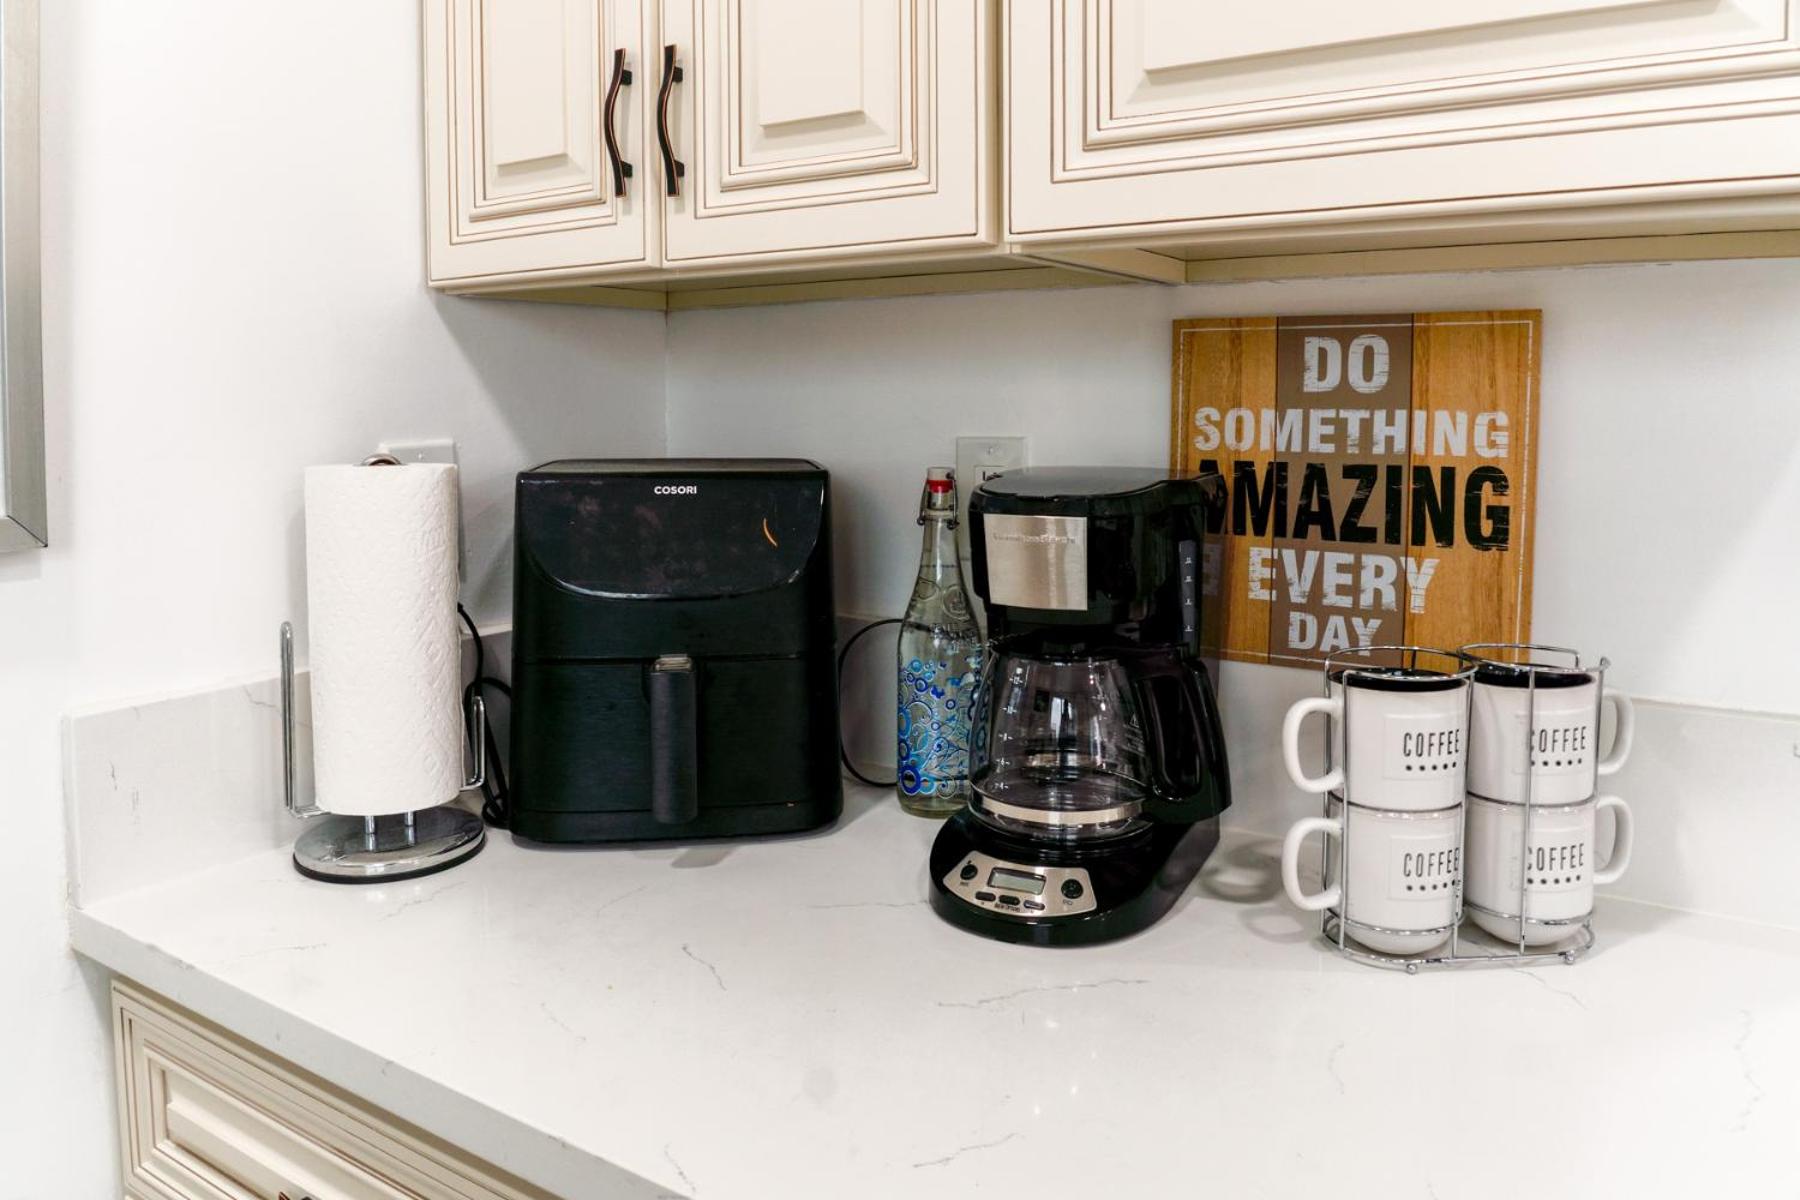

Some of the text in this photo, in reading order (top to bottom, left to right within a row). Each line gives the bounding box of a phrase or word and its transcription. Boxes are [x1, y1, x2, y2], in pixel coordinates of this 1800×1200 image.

[1303, 334, 1390, 394] DO
[1194, 407, 1509, 458] SOMETHING
[653, 485, 698, 495] COSORI
[1248, 547, 1441, 614] EVERY
[1288, 611, 1383, 656] DAY
[1403, 729, 1460, 757] COFFEE
[1403, 847, 1460, 877] COFFEE
